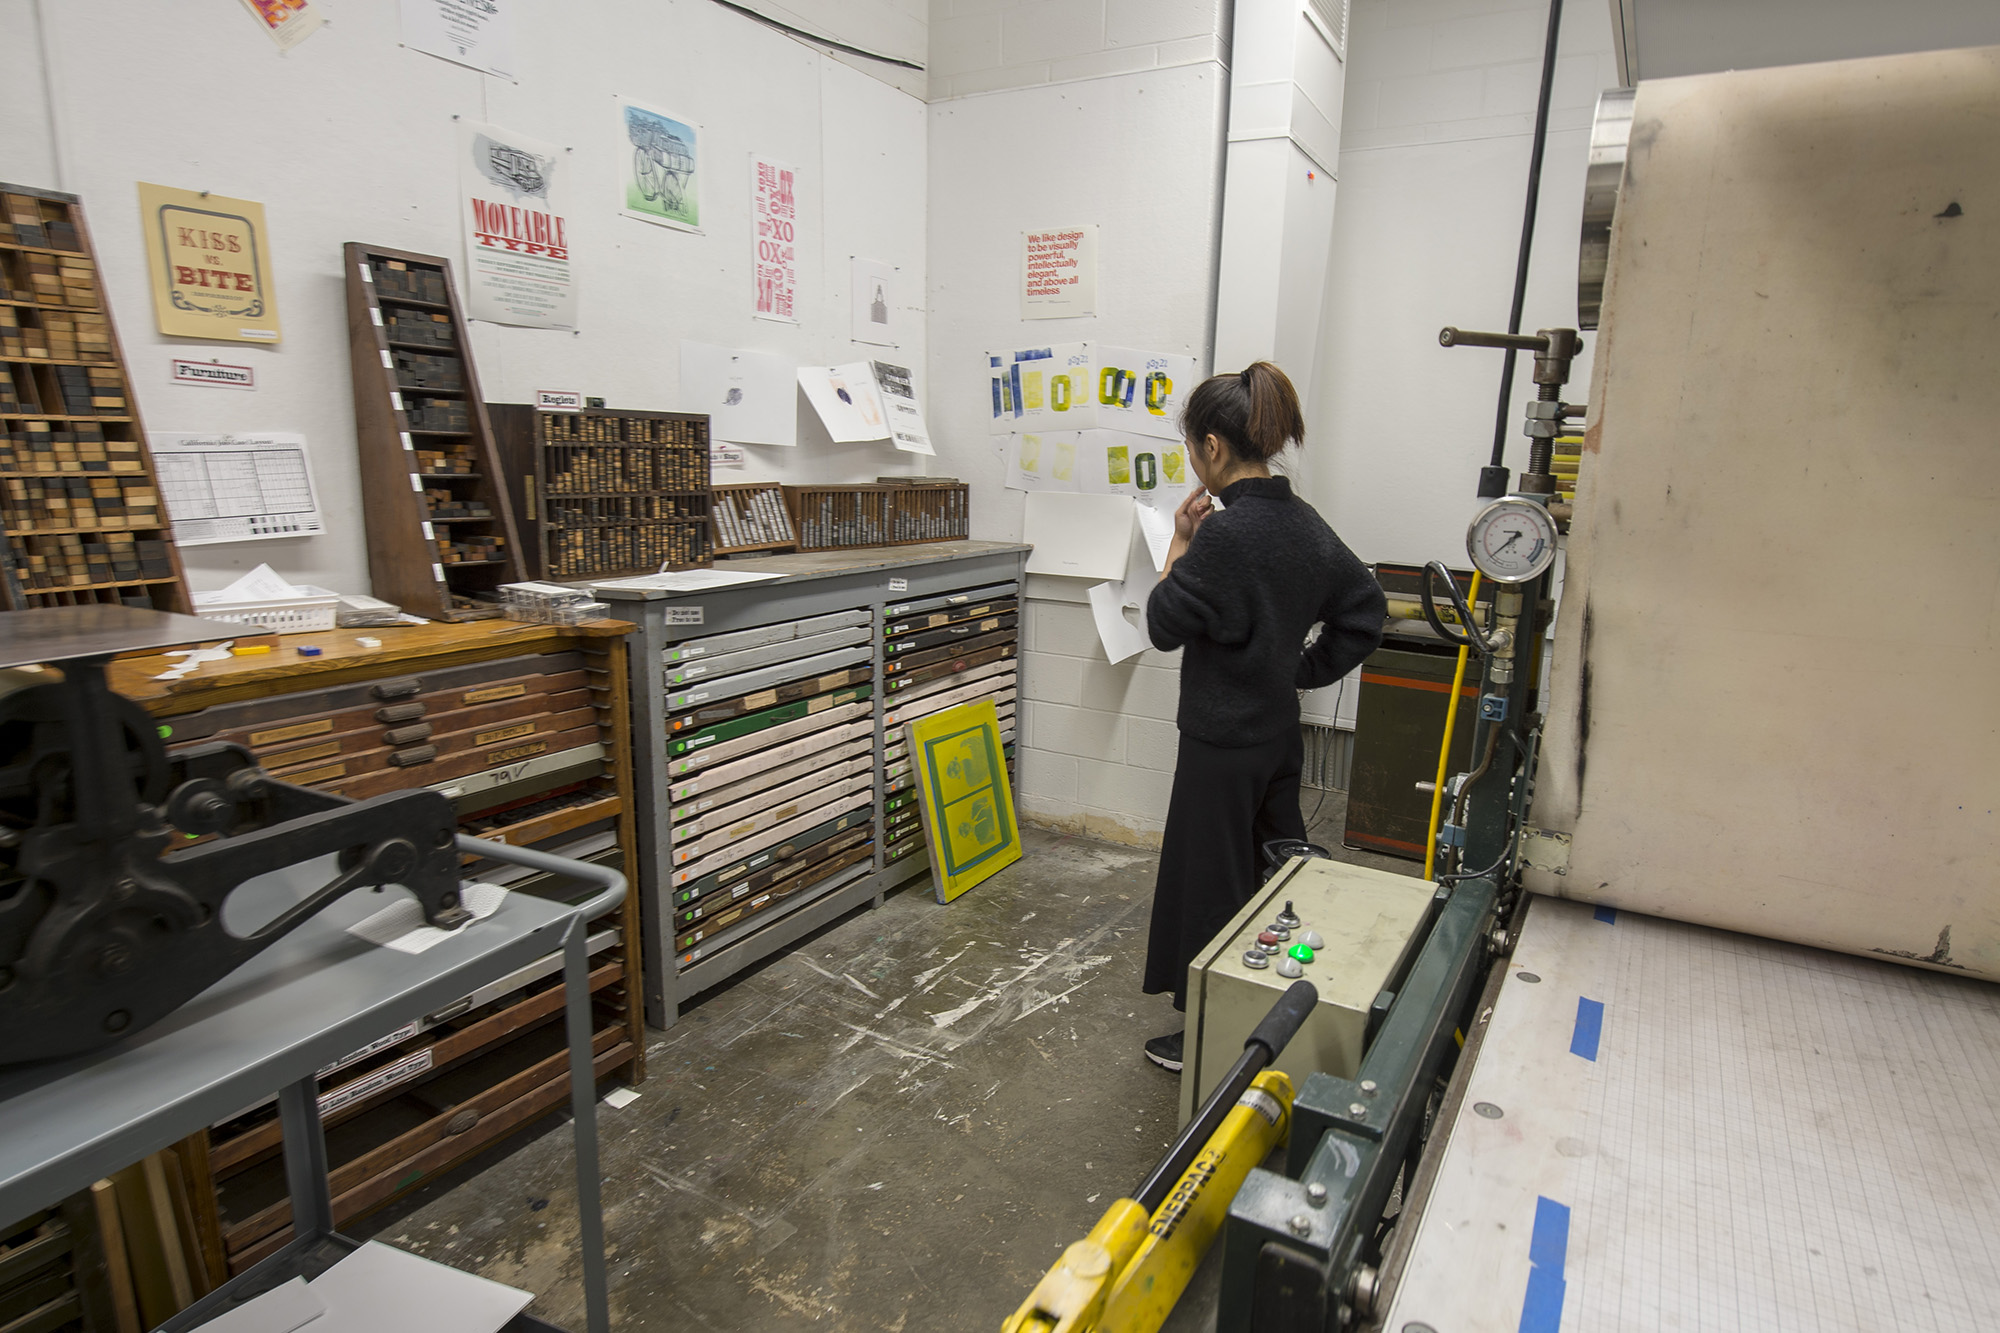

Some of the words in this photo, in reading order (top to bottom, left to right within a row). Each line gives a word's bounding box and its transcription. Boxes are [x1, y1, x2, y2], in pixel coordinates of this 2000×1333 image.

[471, 198, 568, 249] MOVEABLE
[177, 226, 242, 253] KISS
[1027, 235, 1041, 243] We
[1042, 233, 1056, 242] like
[1057, 231, 1084, 241] design
[474, 232, 569, 260] TYPE
[1027, 244, 1036, 252] to
[1037, 243, 1047, 251] be
[1049, 240, 1079, 250] visually
[1027, 251, 1065, 262] powerful,
[1027, 259, 1078, 270] intellectually
[174, 265, 254, 292] BITE
[1027, 269, 1059, 279] elegant,
[1027, 279, 1042, 287] and
[1044, 278, 1067, 286] above
[1069, 275, 1079, 284] all
[1026, 287, 1060, 296] timeless
[179, 364, 247, 381] Furniture
[542, 395, 577, 404] Reglets
[371, 1038, 392, 1050] Wood
[393, 1028, 413, 1041] Type
[331, 1094, 350, 1106] Line
[350, 1080, 384, 1098] Random
[386, 1069, 406, 1081] Wood
[407, 1059, 427, 1072] Type
[1150, 1160, 1218, 1241] ENERPAC
